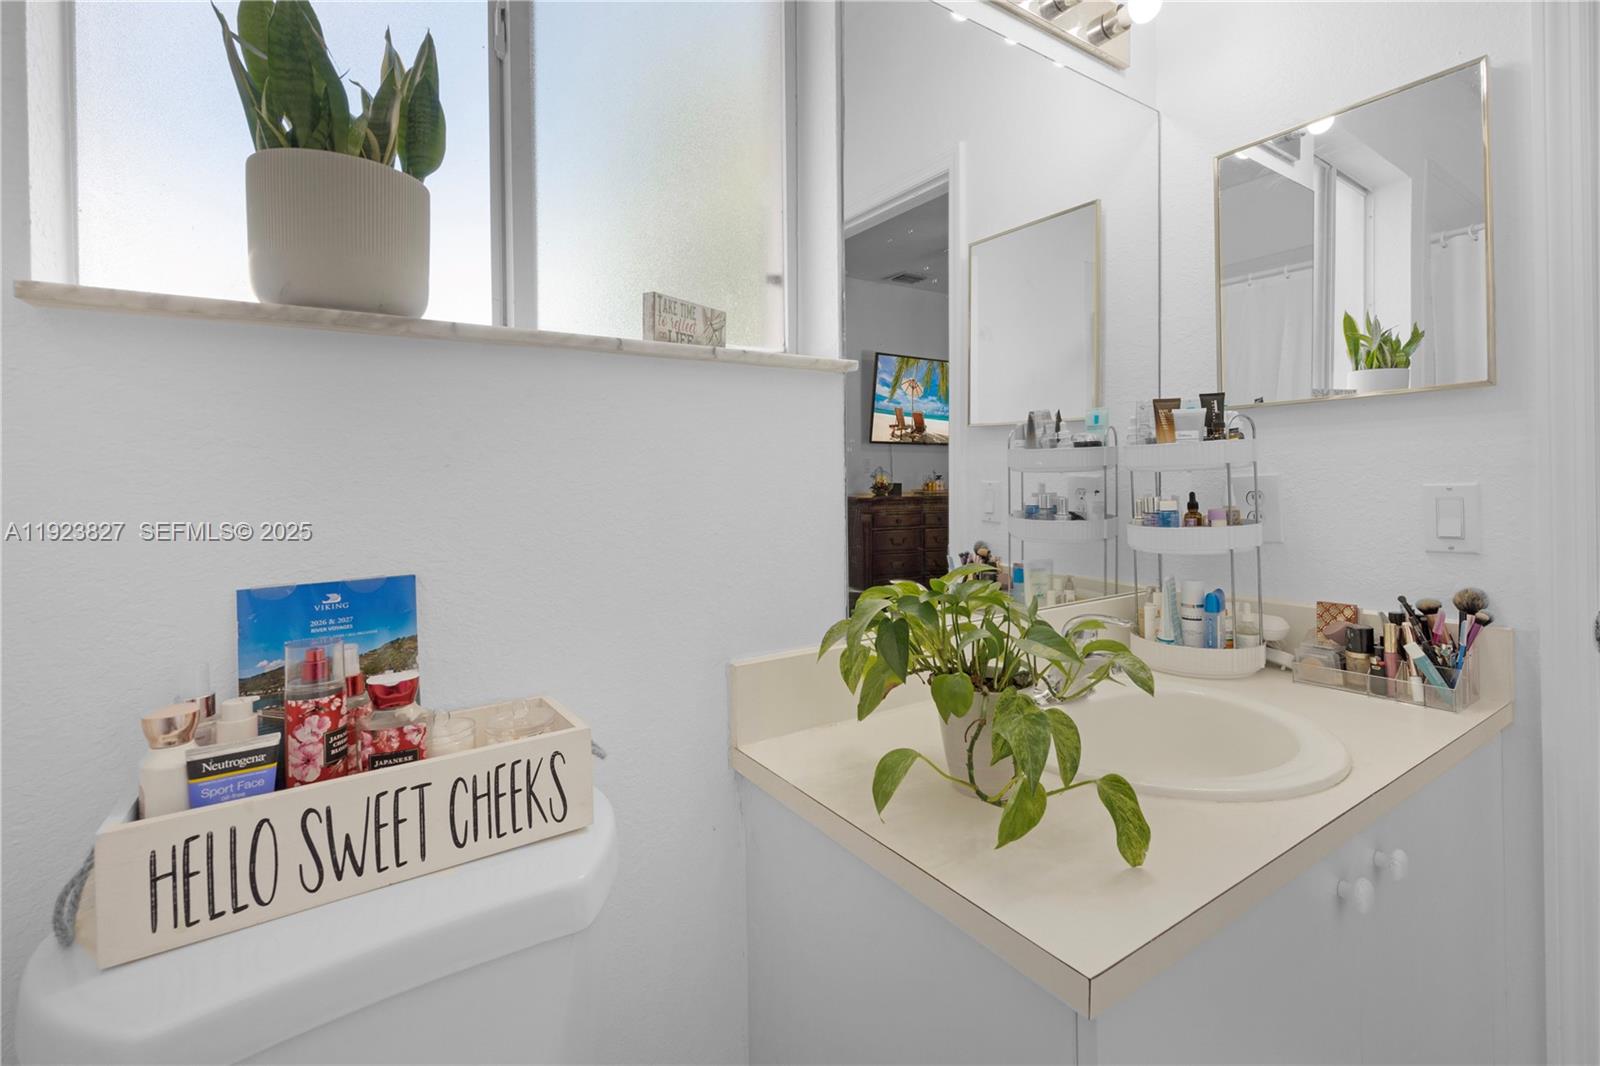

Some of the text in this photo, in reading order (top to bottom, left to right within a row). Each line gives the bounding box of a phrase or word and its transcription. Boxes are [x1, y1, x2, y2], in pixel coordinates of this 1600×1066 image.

[656, 294, 697, 320] TAKE TIME
[314, 603, 350, 612] VIKING
[310, 619, 327, 628] 2026
[337, 616, 354, 625] 2027
[201, 754, 267, 773] Neutrogena
[373, 755, 414, 768] JAPANESE
[200, 779, 265, 799] Sport Face
[149, 750, 567, 933] HELLO SWEET CHEEKS
